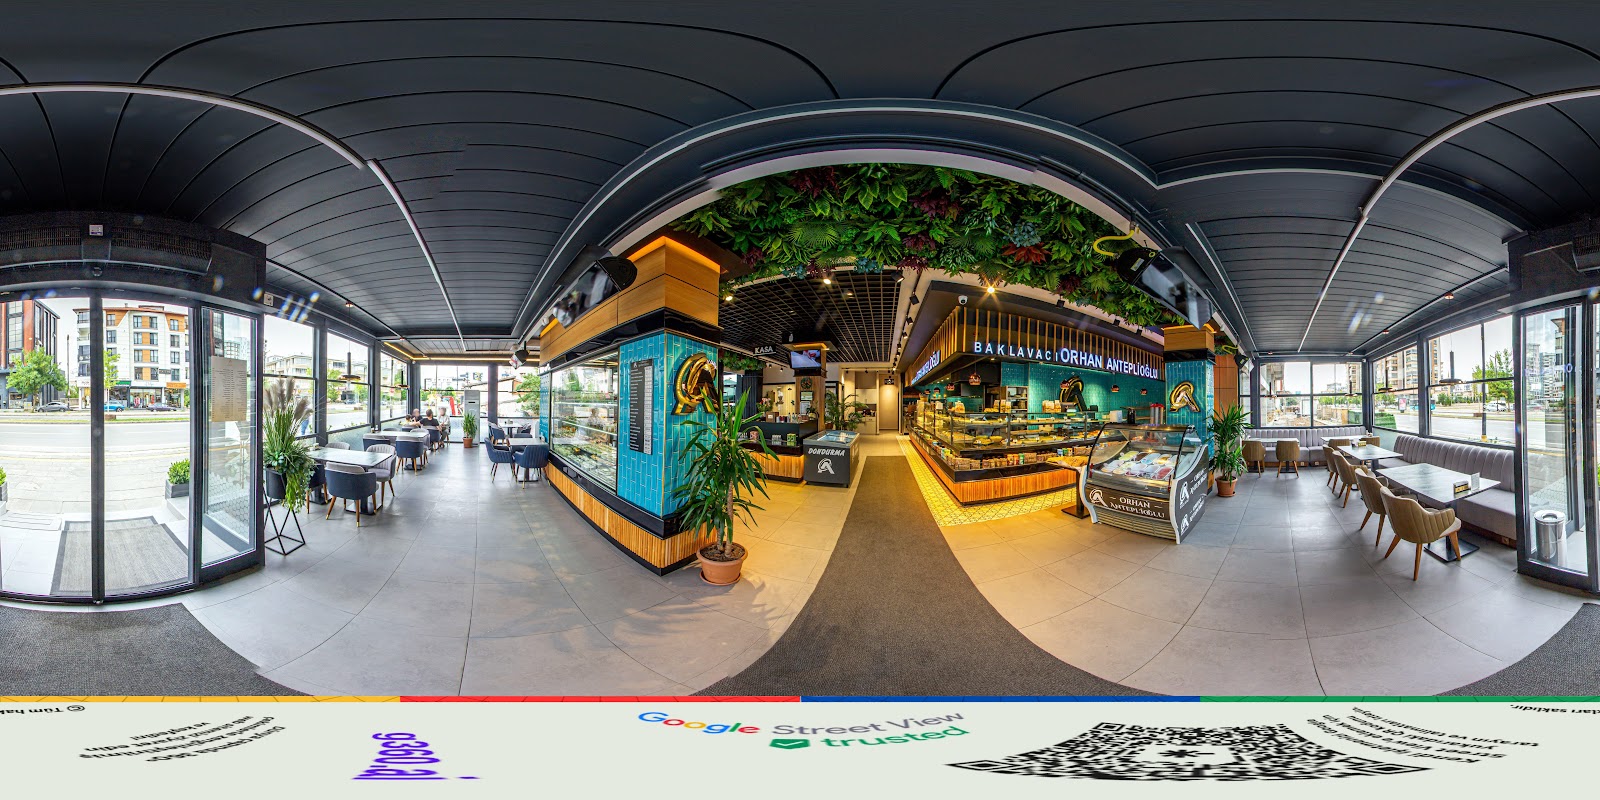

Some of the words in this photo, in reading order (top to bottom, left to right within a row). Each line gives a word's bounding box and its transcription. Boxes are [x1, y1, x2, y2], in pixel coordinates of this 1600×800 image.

[754, 345, 774, 354] KASA
[974, 342, 1059, 362] BAKLAVACI
[1060, 347, 1103, 369] ORHAN
[1106, 357, 1159, 380] ANTEPLİOĞLU
[808, 447, 846, 457] DONDURMA
[1119, 496, 1151, 509] ORHAN
